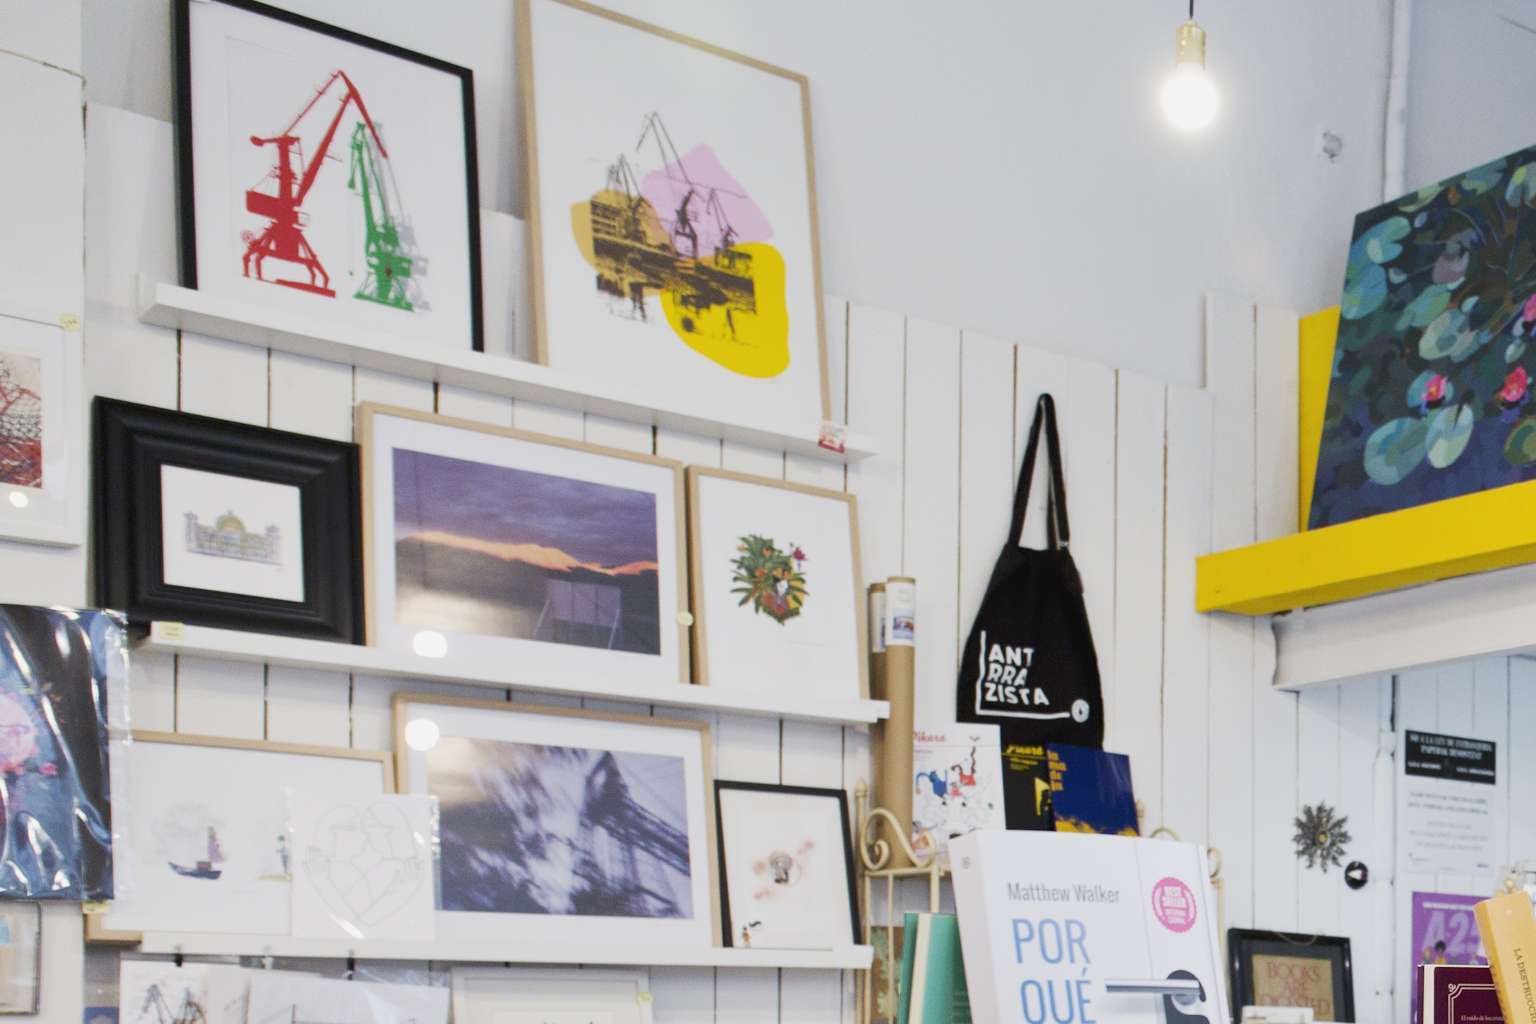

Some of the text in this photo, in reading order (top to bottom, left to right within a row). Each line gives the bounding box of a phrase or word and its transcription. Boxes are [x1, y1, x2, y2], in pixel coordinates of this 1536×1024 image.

[988, 643, 1035, 665] ANT
[984, 683, 1051, 706] ZISTA
[1007, 882, 1121, 905] Matthew Walker
[1011, 917, 1092, 966] POR
[1514, 947, 1523, 962] LA
[1266, 961, 1322, 982] BOOKS
